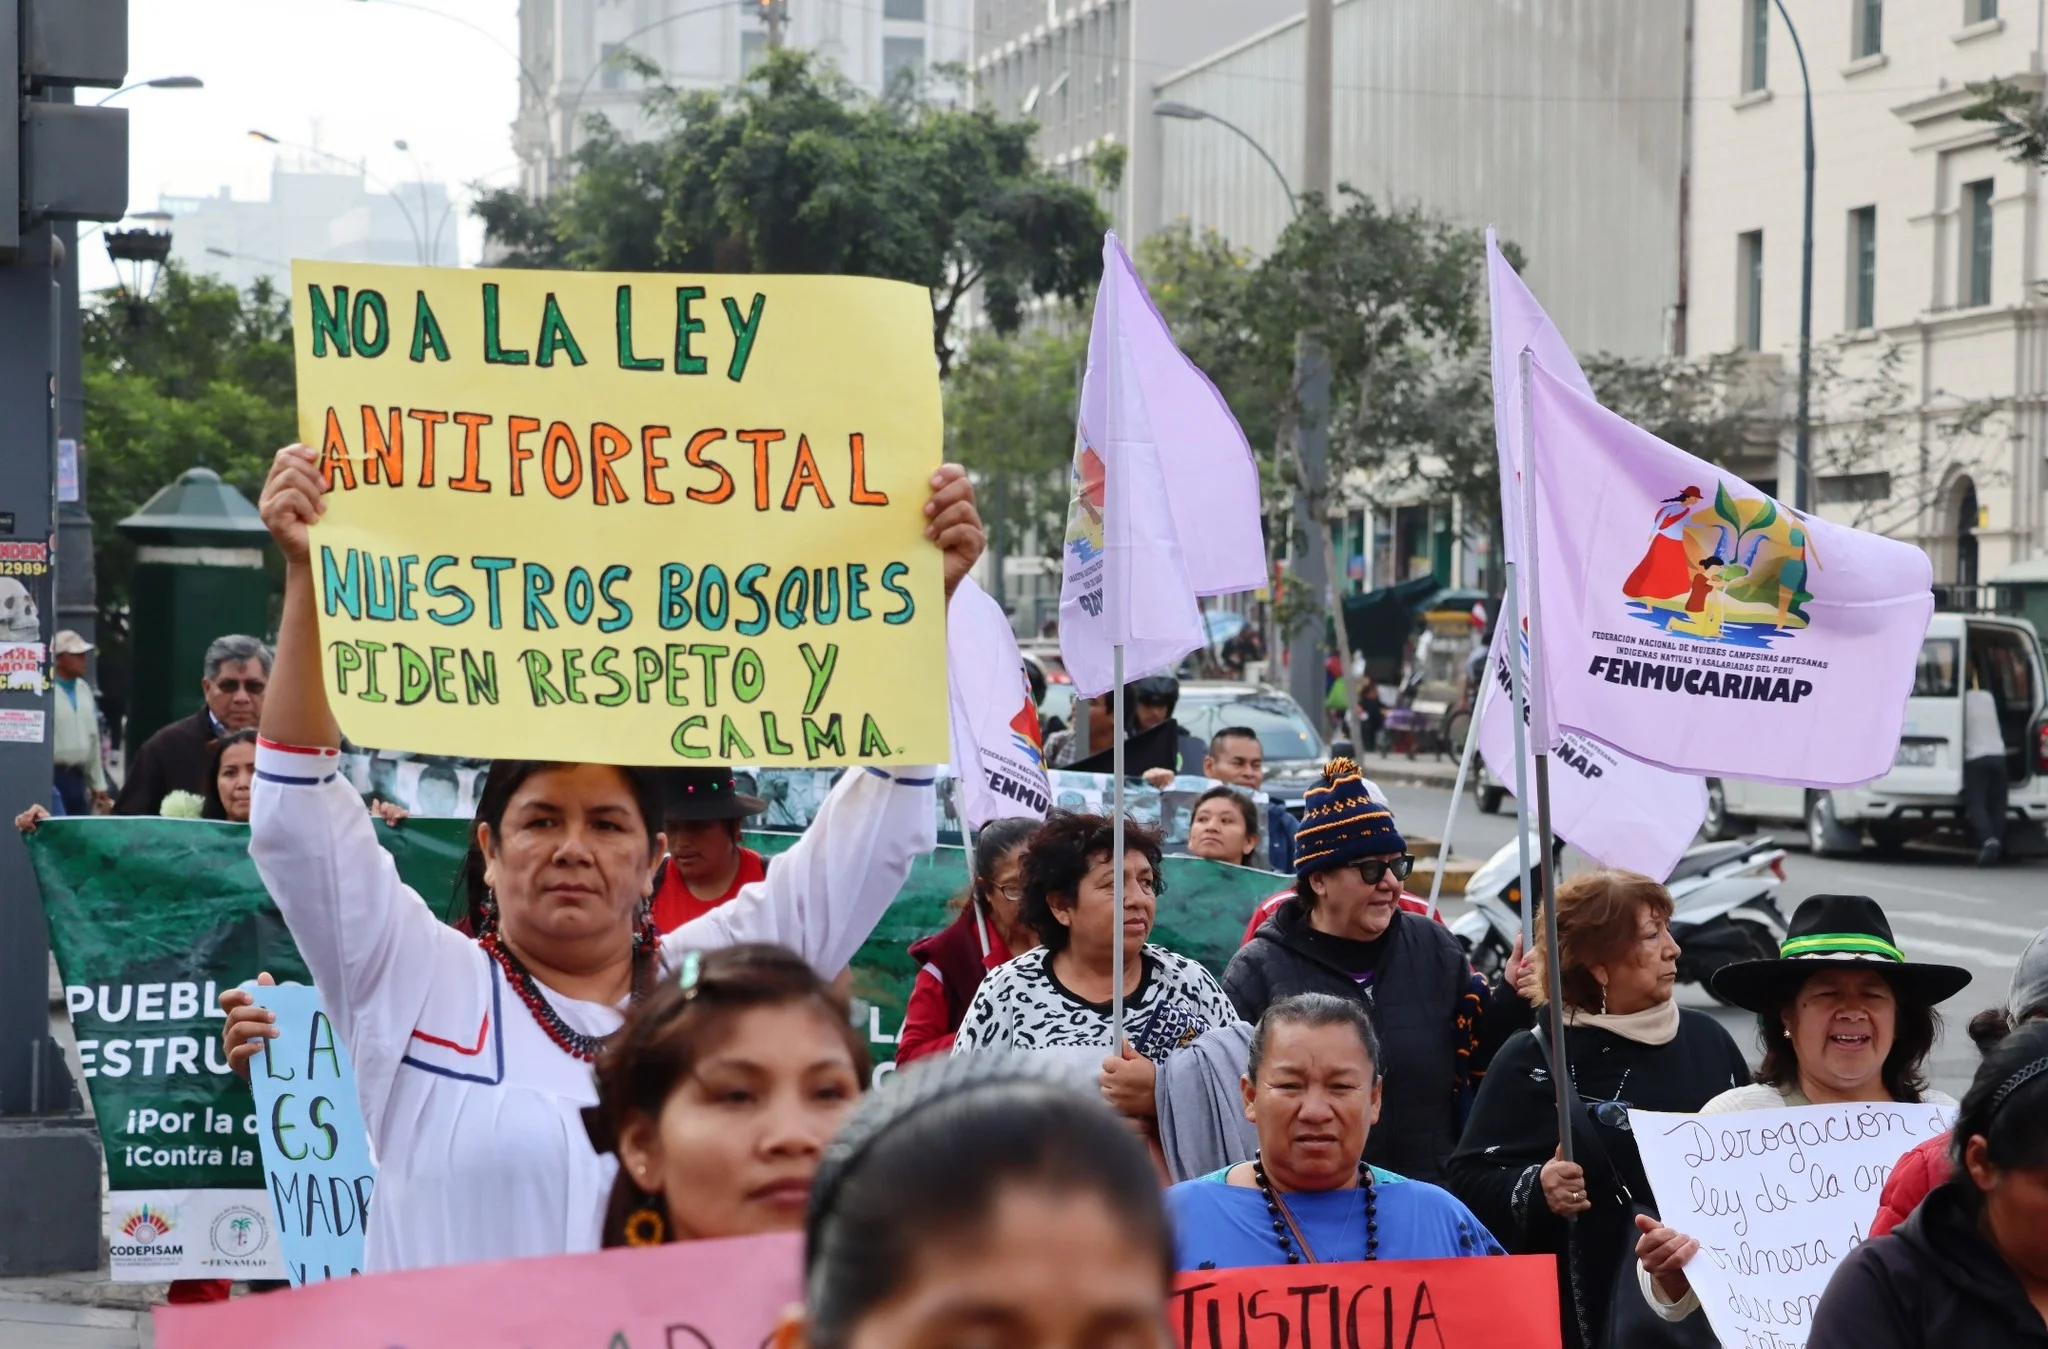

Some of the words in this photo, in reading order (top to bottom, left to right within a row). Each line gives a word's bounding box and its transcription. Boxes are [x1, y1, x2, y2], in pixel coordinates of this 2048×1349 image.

[308, 284, 389, 358] NO
[410, 291, 450, 362] A
[482, 283, 587, 367] LA
[616, 285, 766, 382] LEY
[321, 545, 633, 633] NUESTROS
[658, 562, 915, 636] BOSQUES
[329, 641, 499, 705] PIDEN
[519, 644, 764, 707] RESPETO
[800, 643, 838, 715] Y
[1638, 638, 1677, 651] NACIONAL
[1678, 643, 1690, 652] DE
[1691, 645, 1727, 657] MUJERES
[1728, 650, 1779, 663] CAMPESINAS
[1781, 656, 1829, 669] ARTESANAS
[1660, 653, 1693, 665] NATIVAS
[1701, 659, 1755, 672] ASALARIADAS
[1756, 664, 1771, 673] DEL
[1588, 655, 1813, 703] FENMUCARINAP
[671, 711, 905, 760] CALMA.
[260, 1006, 341, 1081] LA
[204, 1107, 233, 1134] la
[271, 1093, 339, 1161] ES
[231, 1146, 254, 1166] la
[1690, 1176, 1748, 1236] ley
[1755, 1172, 1797, 1213] de
[1807, 1163, 1844, 1203] la
[110, 1245, 183, 1256] CODEPISAM
